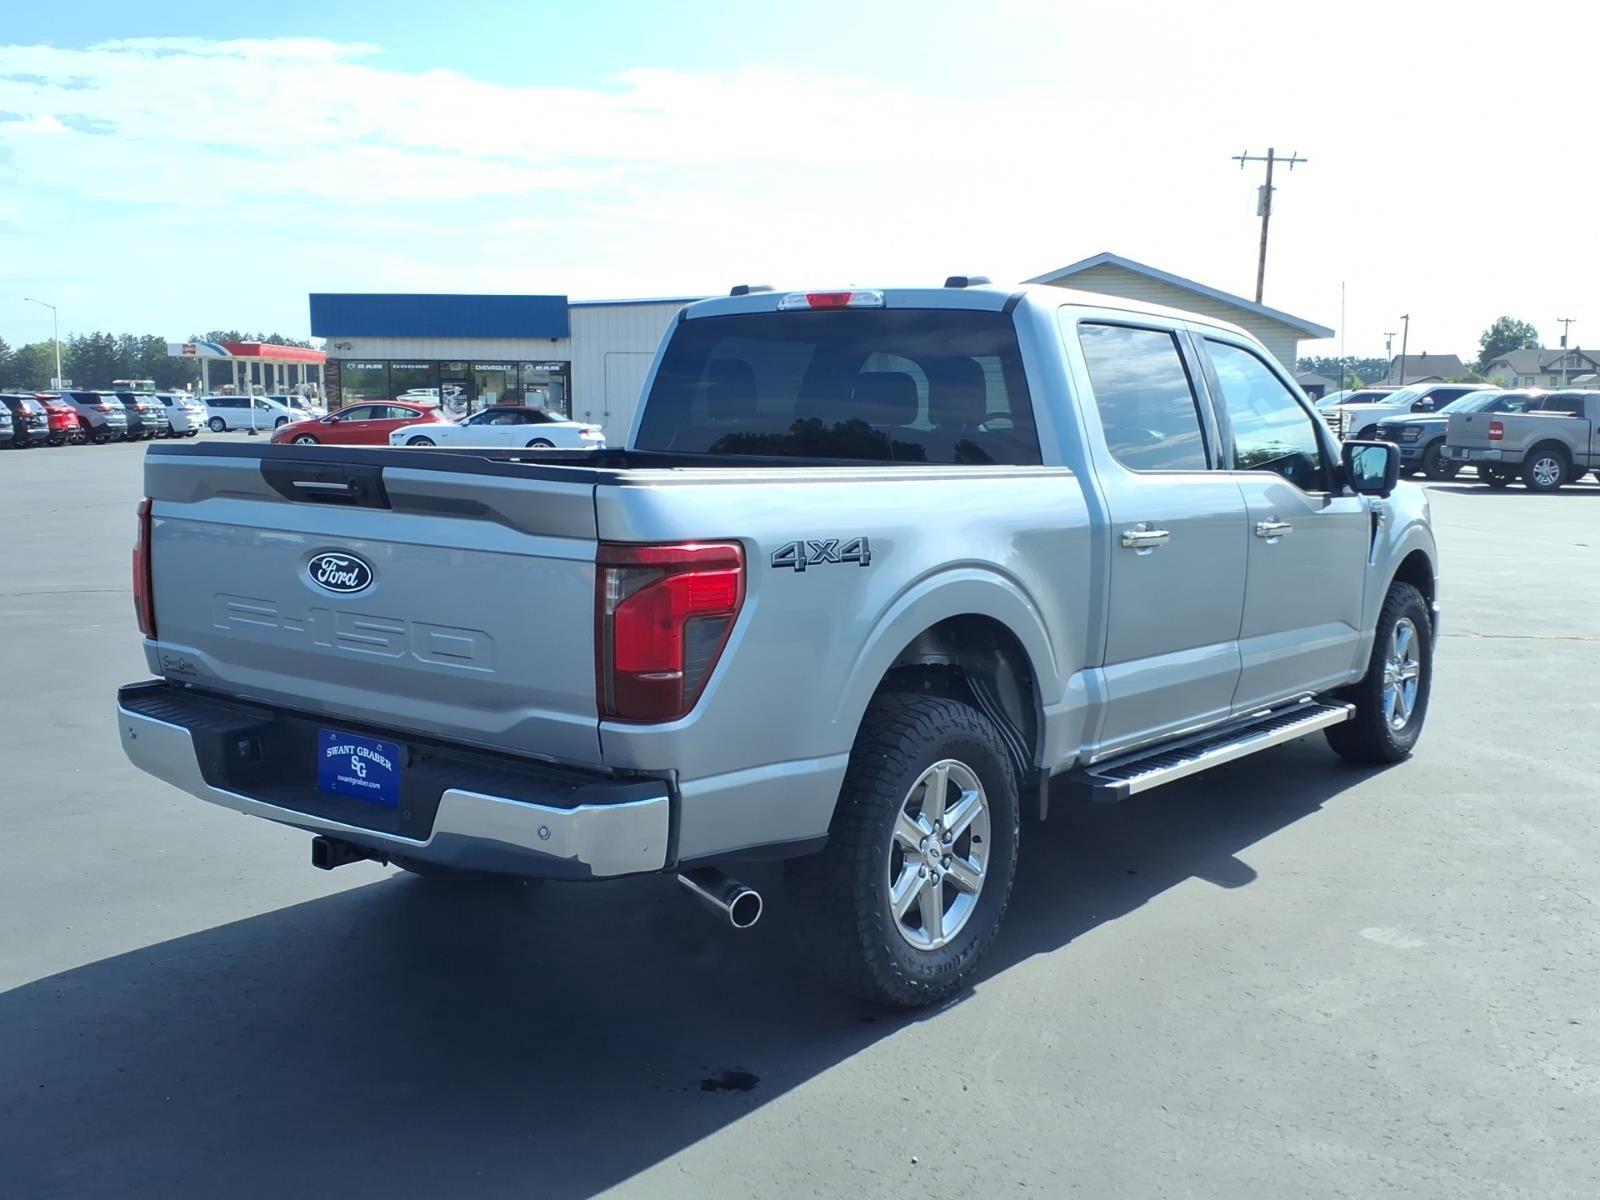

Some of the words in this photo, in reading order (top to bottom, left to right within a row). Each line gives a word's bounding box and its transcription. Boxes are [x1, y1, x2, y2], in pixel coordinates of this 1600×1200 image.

[317, 556, 360, 588] Ford
[213, 592, 496, 674] F-150
[326, 745, 356, 757] SWANT
[356, 746, 393, 772] GRABER
[351, 755, 367, 778] SG
[337, 775, 381, 790] swantgraber.com
